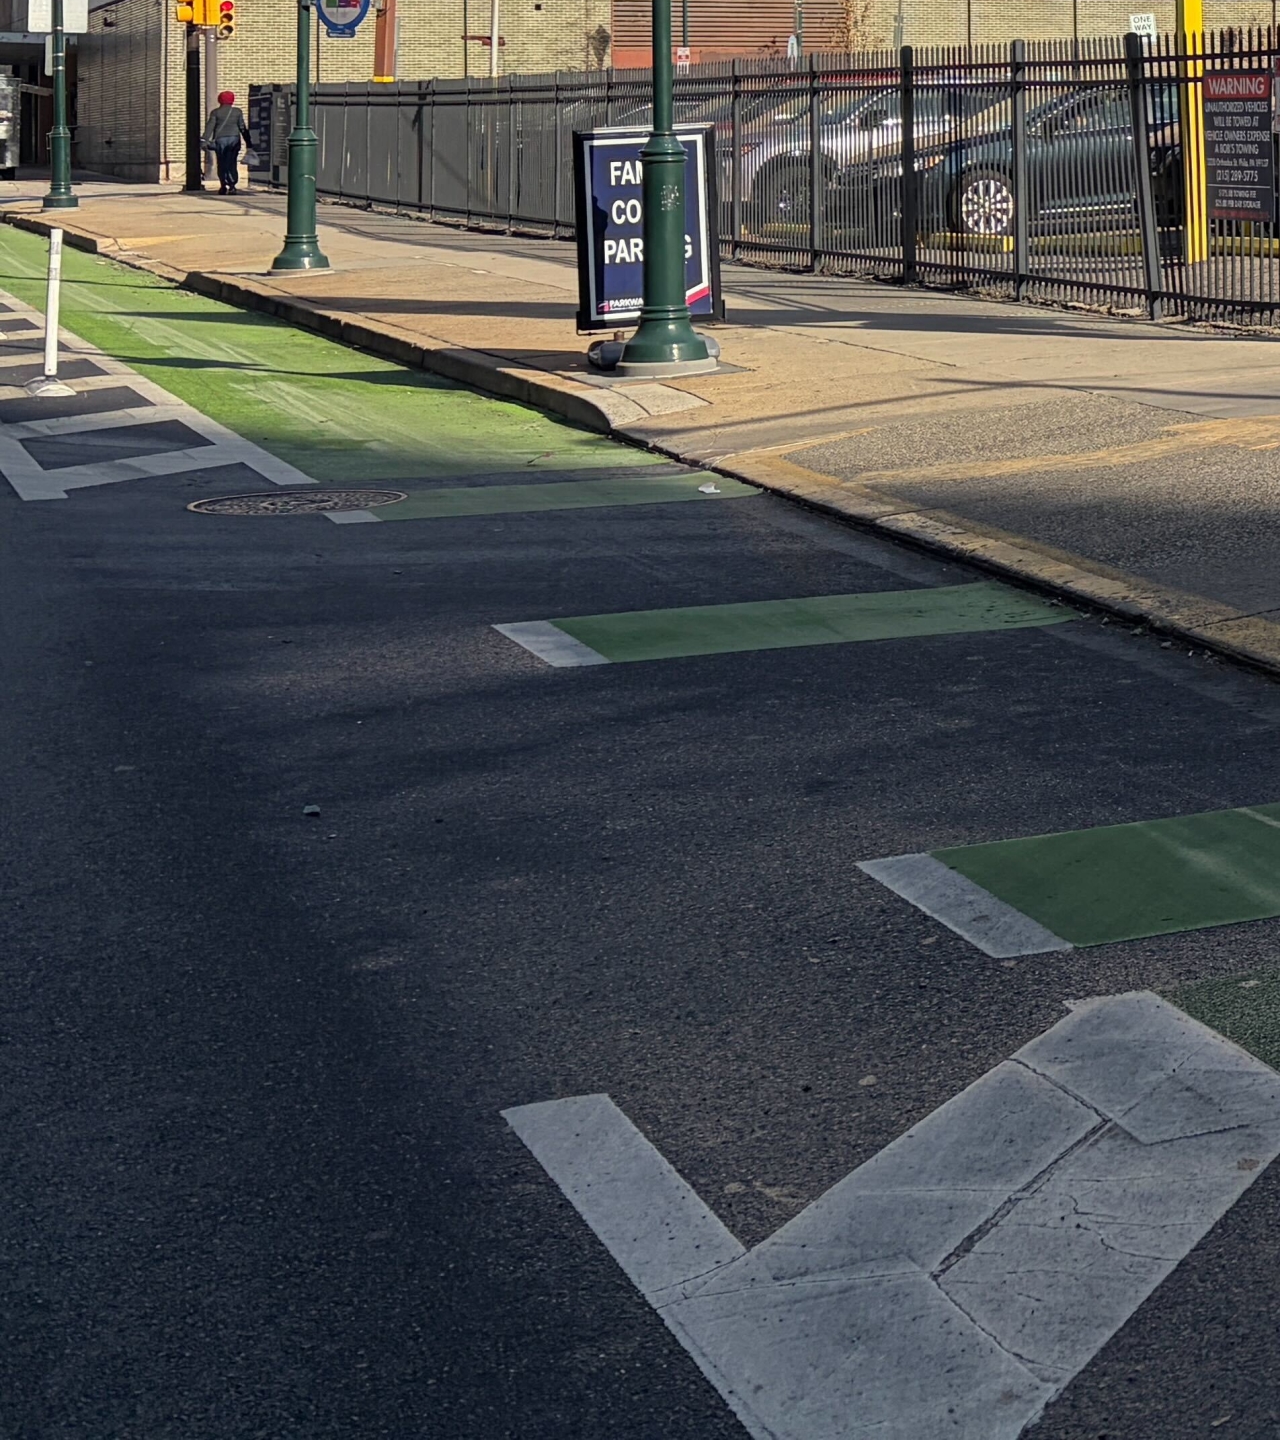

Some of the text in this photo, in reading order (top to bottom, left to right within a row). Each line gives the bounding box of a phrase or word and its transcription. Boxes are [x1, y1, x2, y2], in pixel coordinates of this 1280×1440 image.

[1133, 15, 1152, 24] ONE
[1133, 23, 1152, 31] WAY
[1208, 76, 1265, 95] WARNING
[604, 234, 693, 264] PARG
[609, 297, 644, 308] PARKWA
